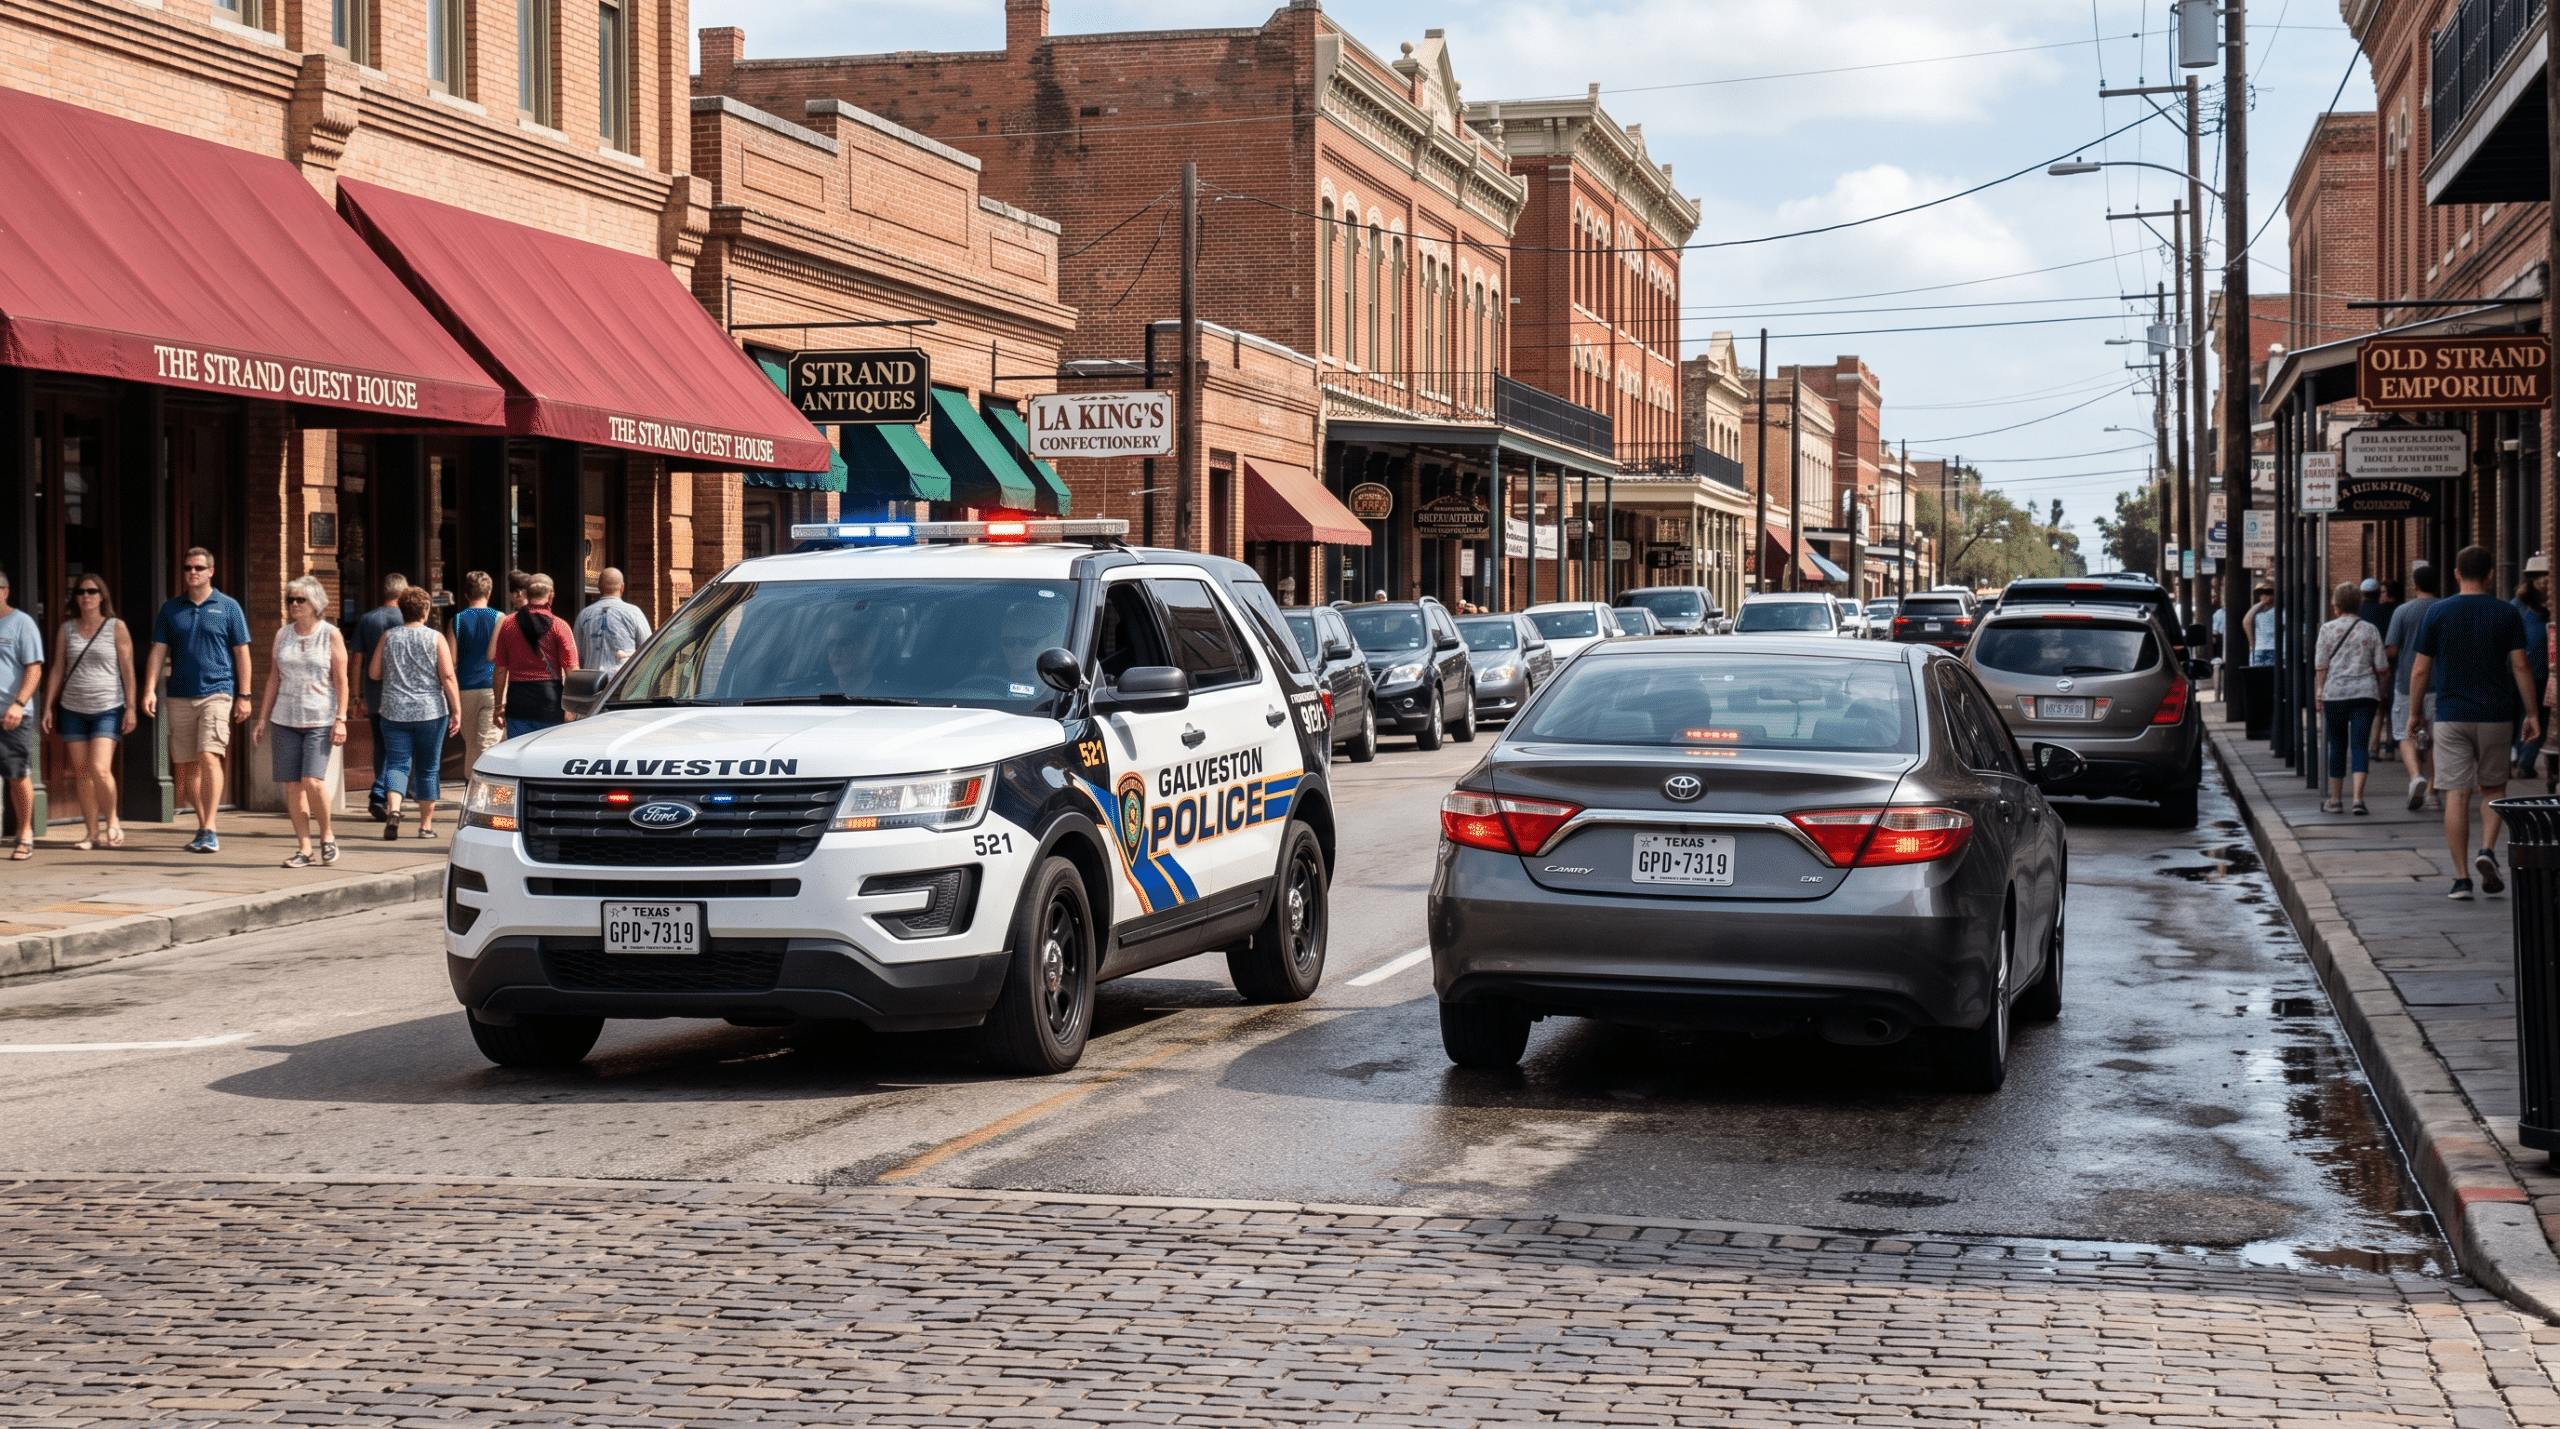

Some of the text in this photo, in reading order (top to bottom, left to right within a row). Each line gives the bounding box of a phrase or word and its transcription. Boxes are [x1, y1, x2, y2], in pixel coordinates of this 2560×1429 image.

[2370, 346, 2546, 371] OLD STRAND
[153, 344, 418, 410] THE STRAND GUEST HOUSE
[801, 361, 916, 387] STRAND
[2379, 374, 2537, 399] EMPORIUM
[800, 390, 916, 414] ANTIQUES
[1037, 402, 1164, 431] LA KING'S
[608, 416, 774, 463] THE STRAND GUEST HOUSE
[1040, 435, 1161, 450] CONFECTIONERY
[1078, 739, 1106, 768] 521
[562, 758, 798, 776] GALVESTON
[1158, 746, 1263, 798] GALVESTON
[642, 805, 680, 822] Ford
[1149, 779, 1264, 856] POLICE
[973, 832, 1013, 857] 521
[1664, 837, 1705, 848] TEXAS
[632, 907, 670, 917] TEXAS
